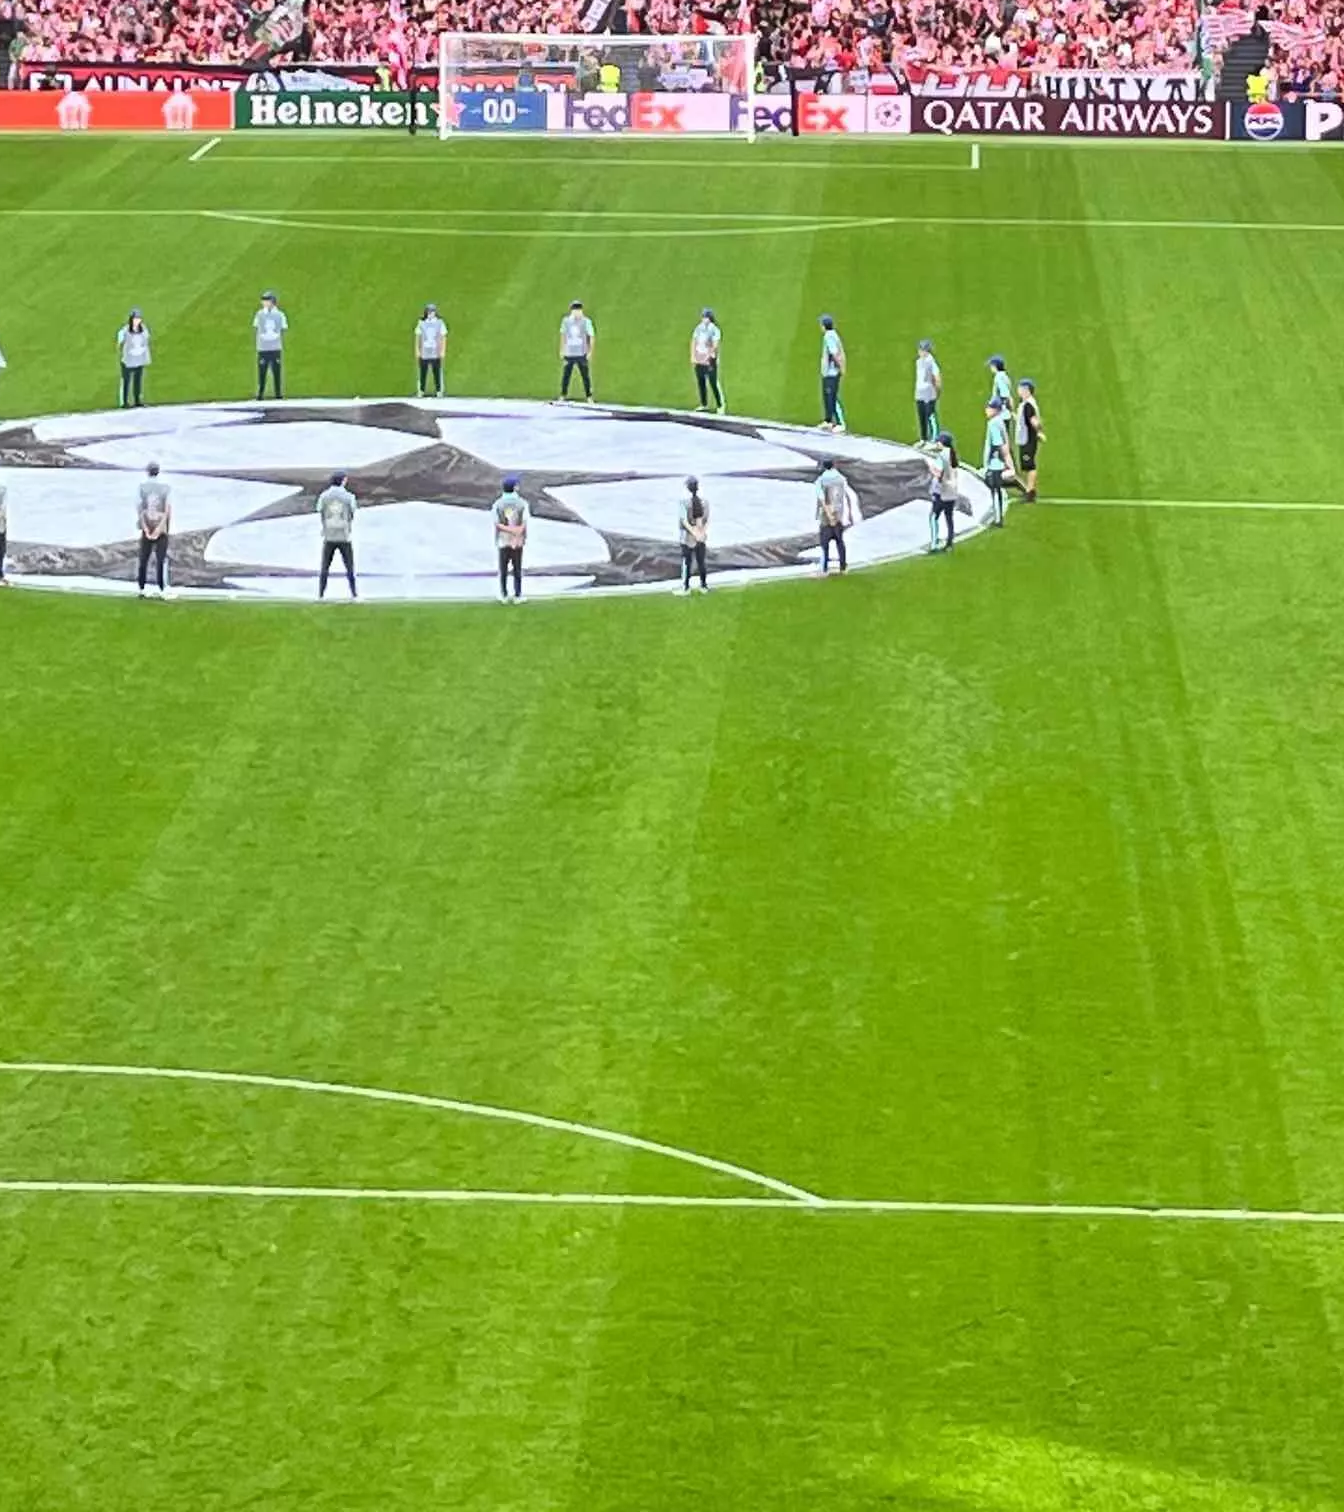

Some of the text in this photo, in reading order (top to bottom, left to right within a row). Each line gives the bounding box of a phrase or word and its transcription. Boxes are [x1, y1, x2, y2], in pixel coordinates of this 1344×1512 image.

[250, 93, 430, 126] Heineken
[565, 92, 684, 131] FedEx
[923, 100, 1213, 135] QATAR AIRWAYS
